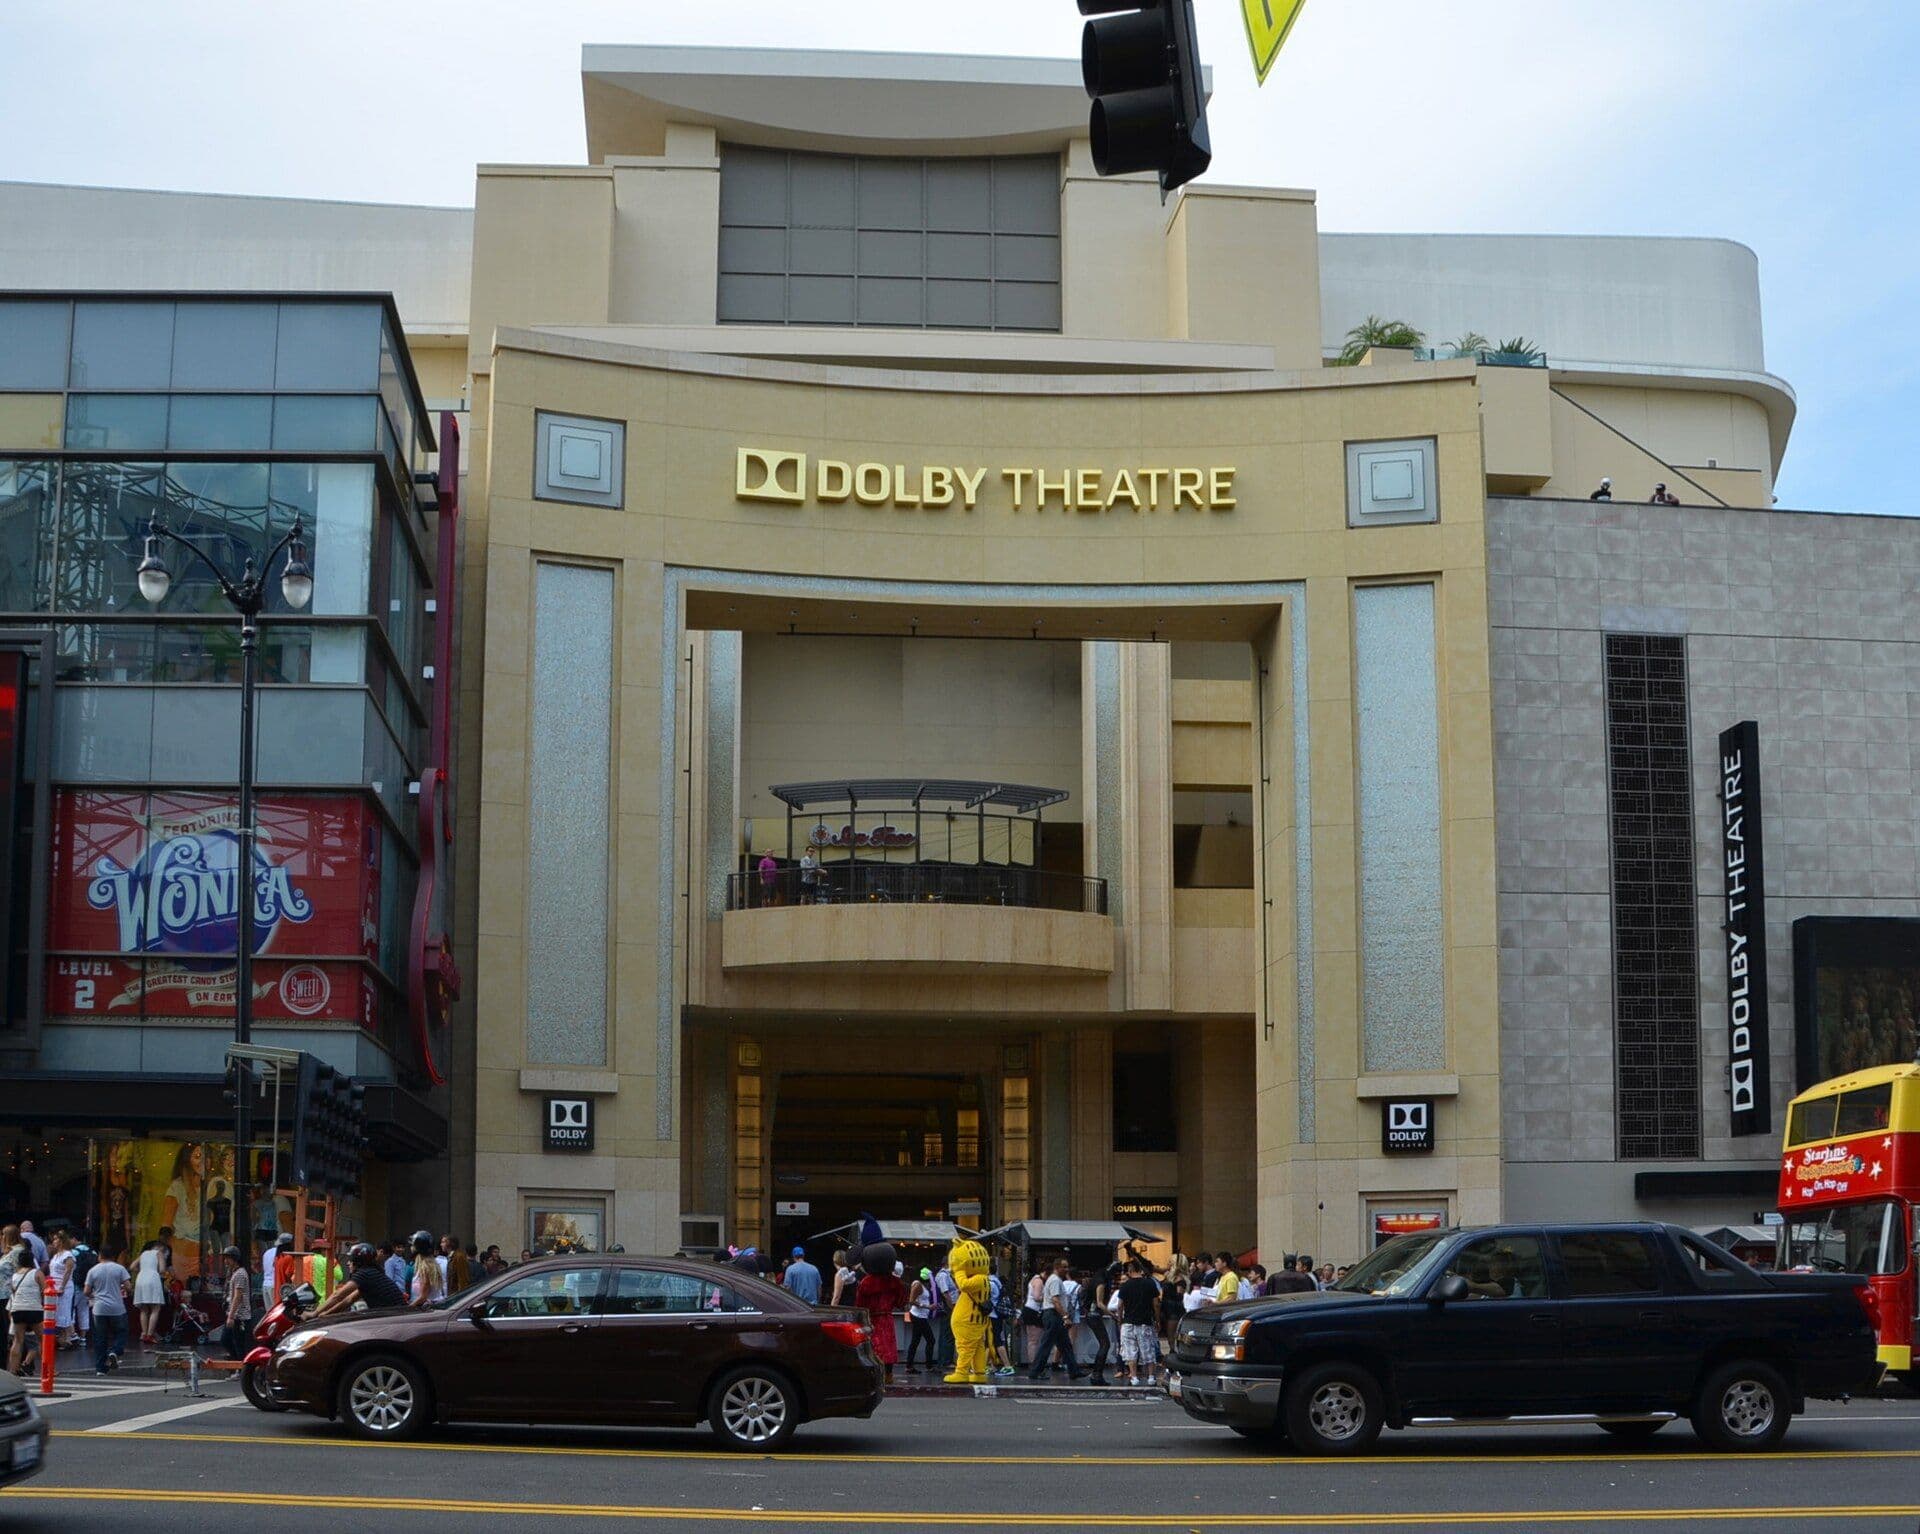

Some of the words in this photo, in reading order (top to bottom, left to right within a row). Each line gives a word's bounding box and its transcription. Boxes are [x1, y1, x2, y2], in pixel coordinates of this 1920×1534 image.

[817, 459, 987, 506] DOLBY
[1002, 467, 1236, 510] THEATRE
[163, 811, 240, 835] FEATURING
[1724, 748, 1746, 921] THEATRE
[59, 960, 113, 976] LEVEL
[146, 974, 187, 988] GREATEST
[190, 975, 217, 986] CANDY
[218, 971, 239, 984] STO
[75, 979, 95, 1009] 2
[196, 991, 208, 1002] ON
[213, 991, 239, 1003] EART
[1730, 929, 1750, 1054] DOLBY
[550, 1129, 587, 1139] DOLBY
[1389, 1131, 1426, 1141] DOLBY
[1803, 1145, 1848, 1165] Starline
[1801, 1186, 1814, 1198] Hop
[1824, 1179, 1836, 1190] Hop
[1836, 1181, 1849, 1193] Off
[1114, 1204, 1137, 1212] LOUIS
[1138, 1204, 1173, 1212] VUITTON
